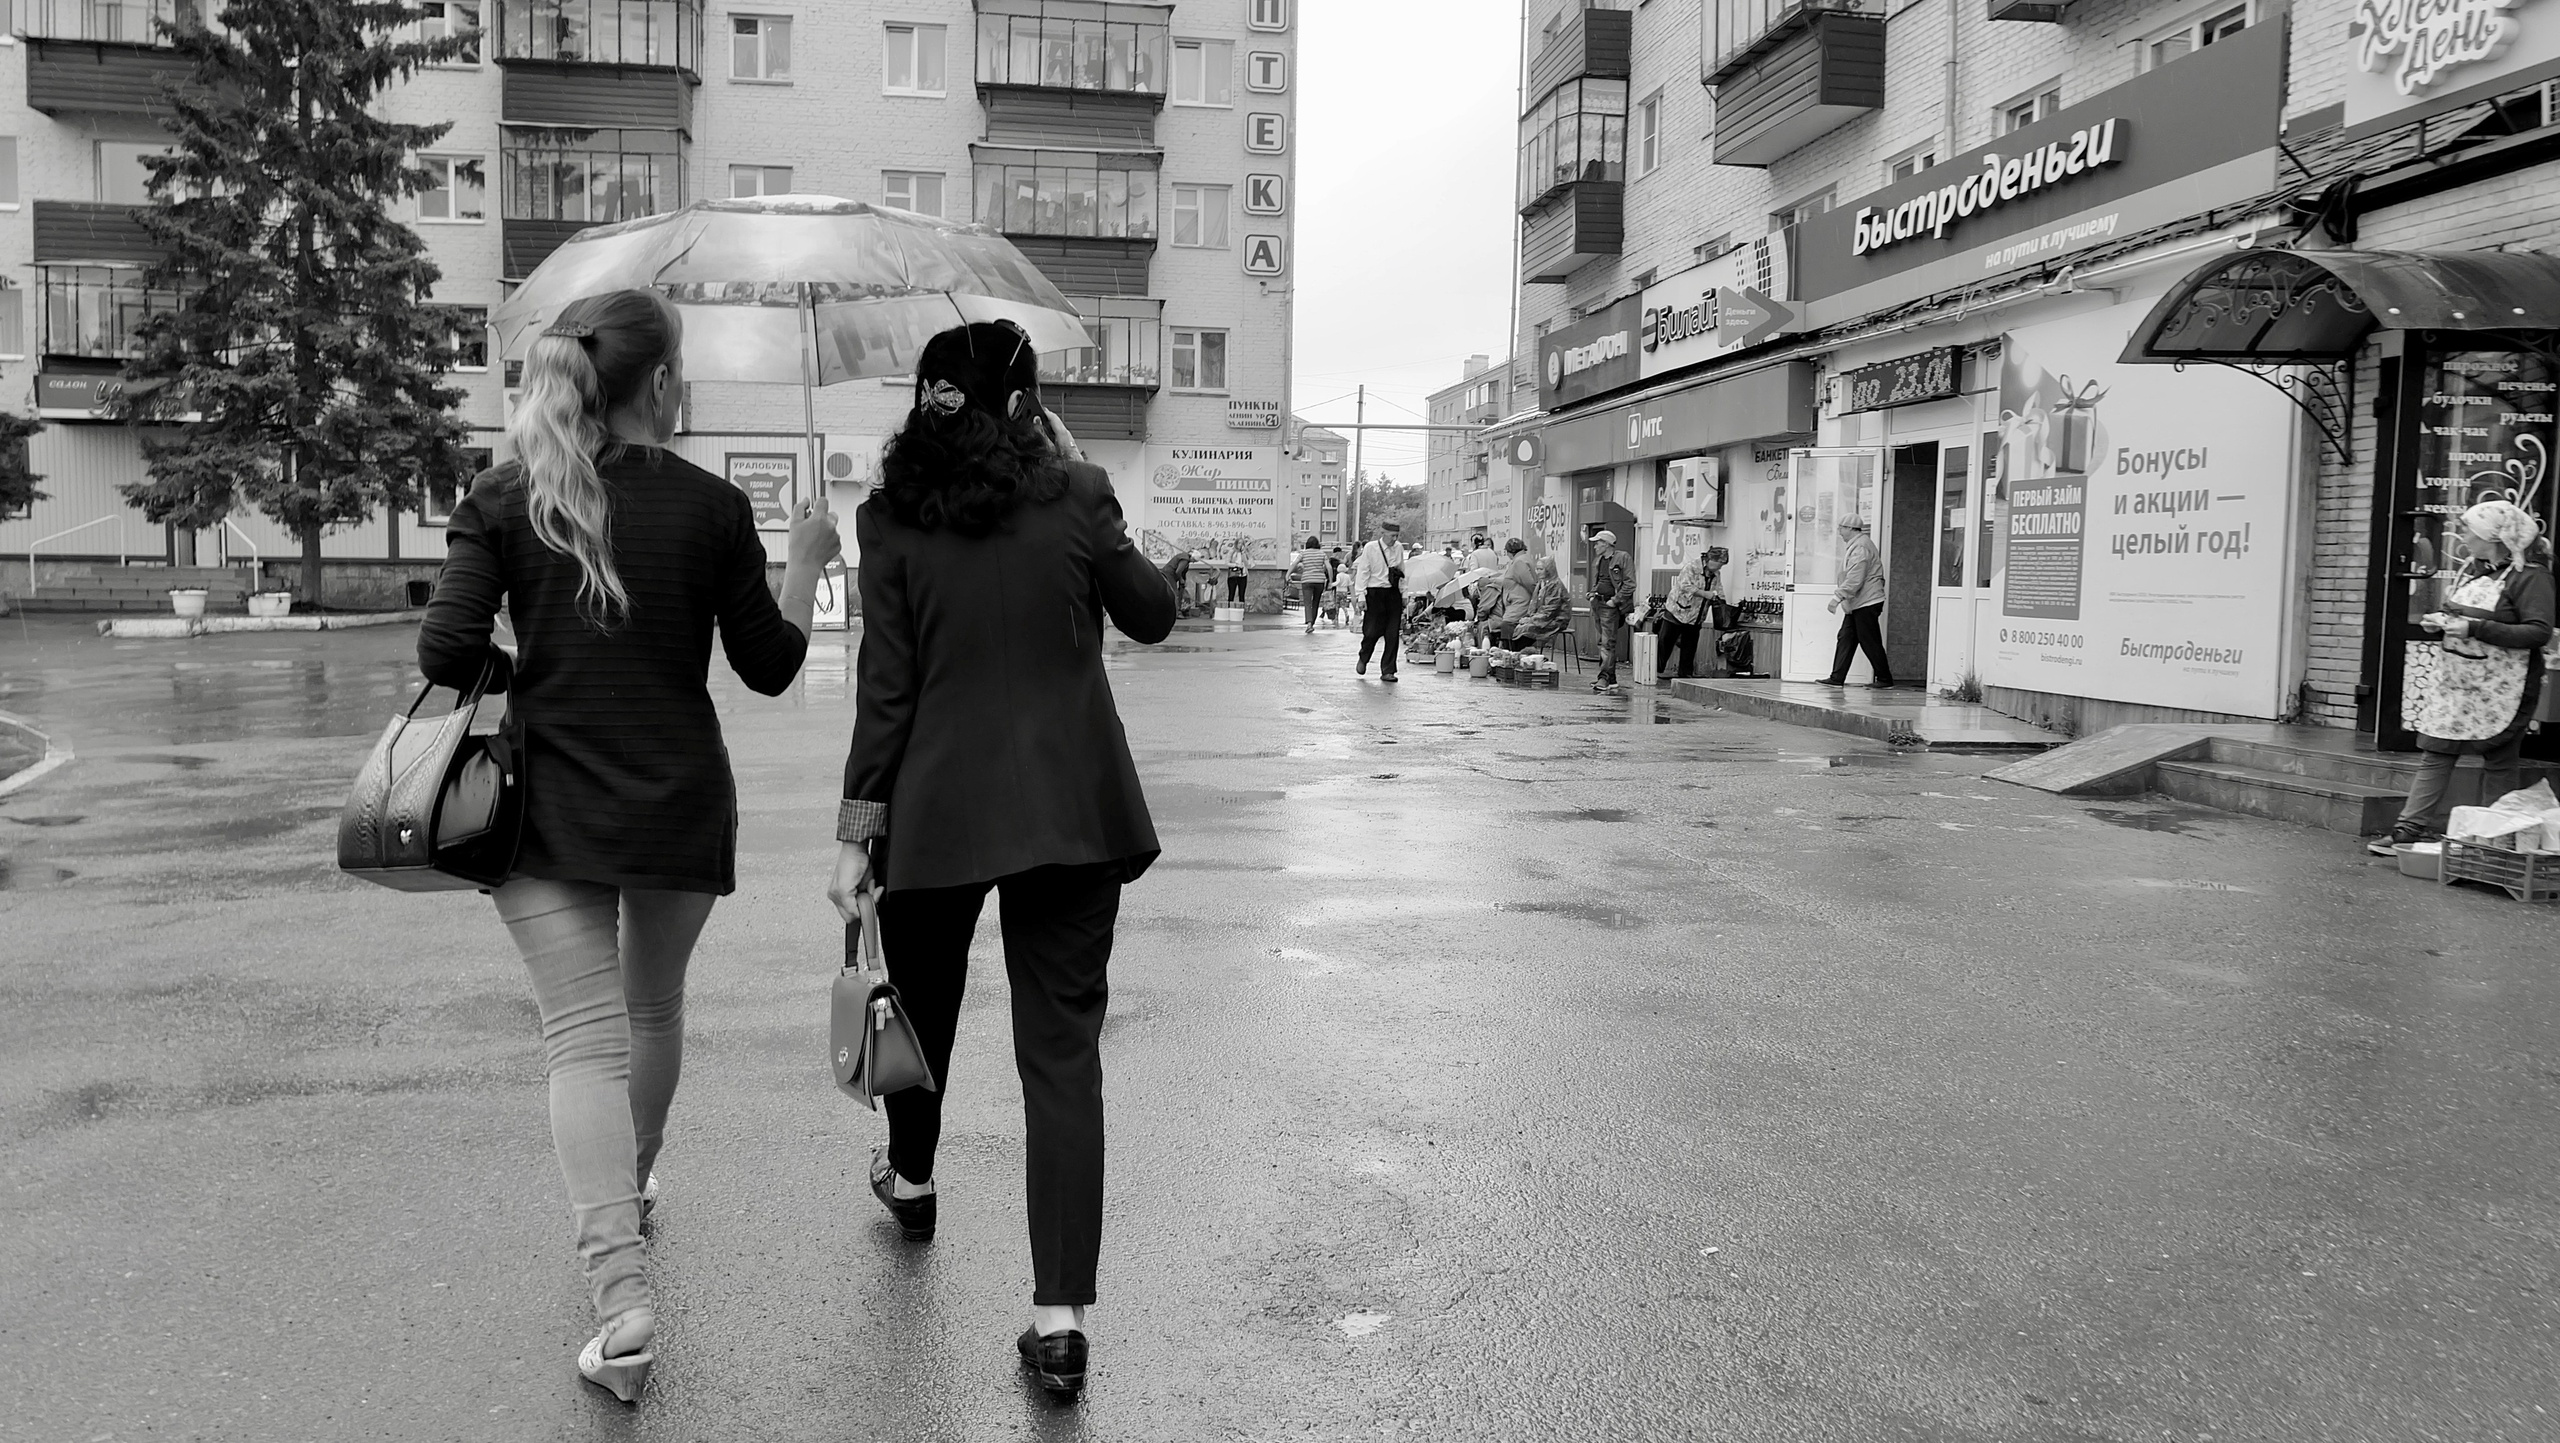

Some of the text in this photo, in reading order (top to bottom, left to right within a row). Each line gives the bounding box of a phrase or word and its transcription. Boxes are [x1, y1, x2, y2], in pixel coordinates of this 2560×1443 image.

[1852, 117, 2118, 256] Быстроденьги
[1984, 212, 2120, 269] на пути к лучшему
[1725, 307, 1757, 317] Деньги
[1725, 319, 1750, 327] здесь
[2443, 360, 2519, 374] пирожное
[48, 379, 87, 389] салон
[2497, 381, 2558, 391] печенье
[1228, 401, 1278, 410] ПУНКТЫ
[2432, 391, 2493, 408] булочки
[1267, 414, 1278, 426] 21
[2499, 412, 2553, 425] рулеты
[1642, 416, 1663, 438] МТС
[2433, 426, 2489, 436] чак-чак
[1172, 449, 1253, 460] КУЛИНАРИЯ
[2448, 452, 2502, 465] пироги
[733, 461, 790, 470] УРАЛОБУВЬ
[2116, 446, 2209, 480] Бонусы
[1181, 464, 1222, 480] Жар
[749, 481, 774, 489] УДОБНАЯ
[1215, 480, 1269, 492] ПИЦЦА
[2425, 477, 2472, 490] торты
[752, 491, 770, 499] ОБУВЬ
[1153, 496, 1274, 506] ПИЦЦА ВЫПЕЧКА ПИРОГИ
[2012, 486, 2053, 508] ПЕРВЫЙ
[2053, 484, 2082, 505] ЗАЙМ
[2113, 493, 2128, 515] и
[2133, 489, 2210, 519] акции
[2423, 504, 2468, 514] кексы
[1174, 506, 1252, 516] САЛАТЫ НА ЗАКАЗ
[1157, 520, 1206, 529] ДОСТАВКА:
[2010, 511, 2081, 536] БЕСПЛАТНО
[1656, 519, 1685, 565] 43
[2111, 522, 2251, 560] целый год!
[2011, 629, 2084, 649] 8 800 250 40 00
[2120, 637, 2243, 664] Быстроденьги
[2040, 653, 2083, 667] bistrodengi.ru
